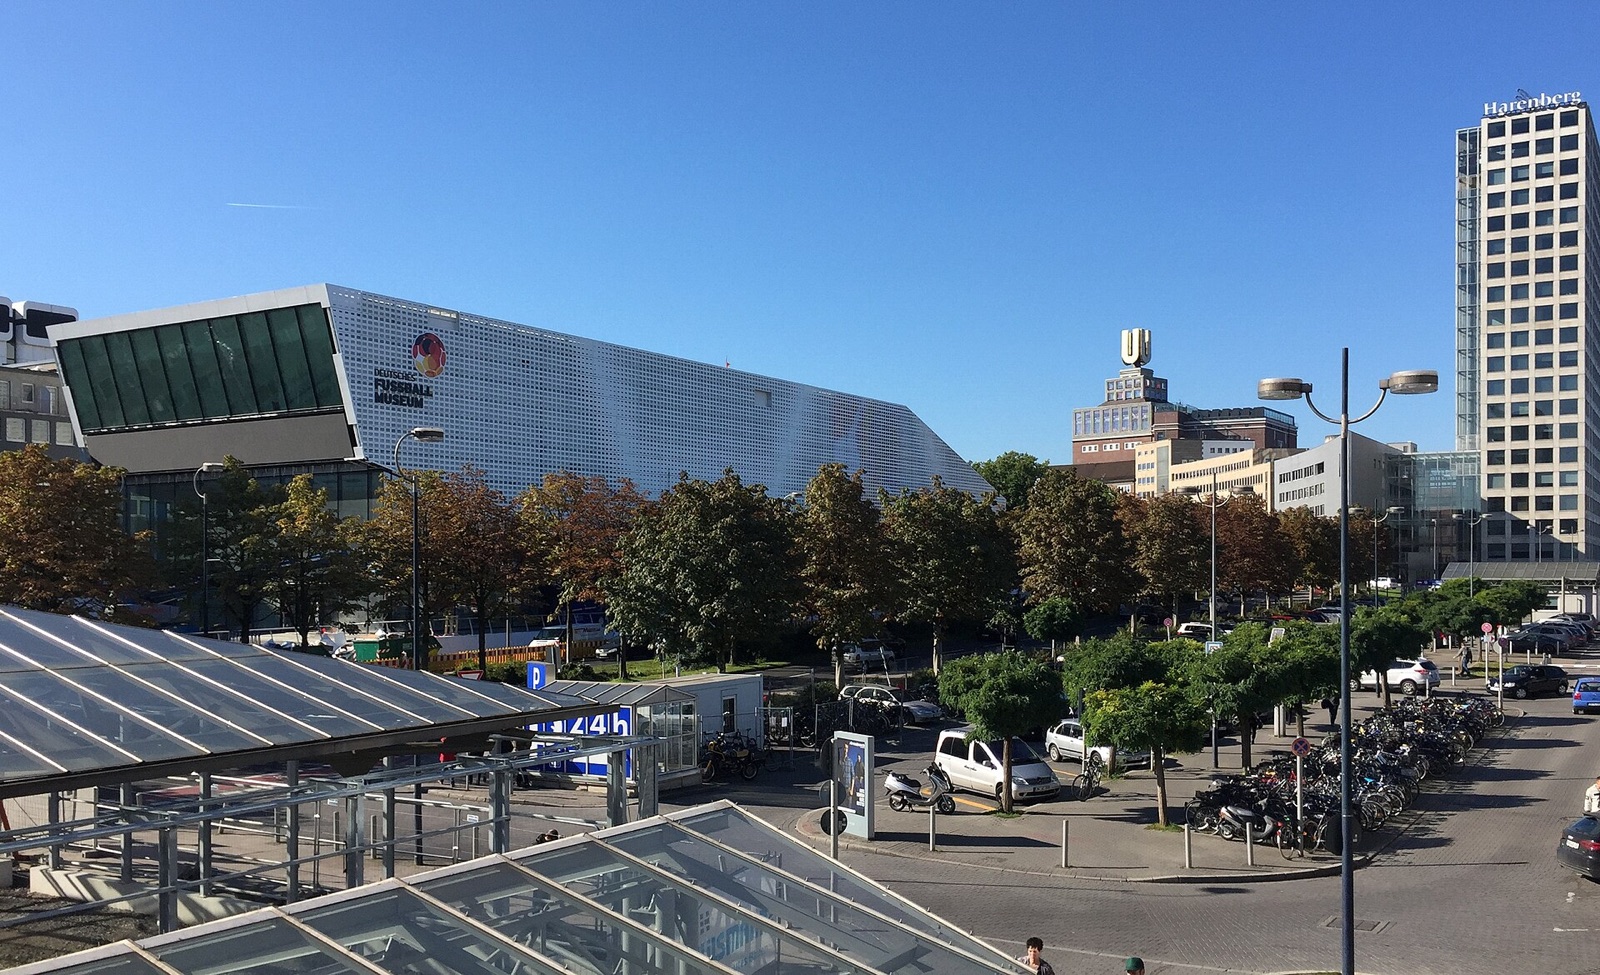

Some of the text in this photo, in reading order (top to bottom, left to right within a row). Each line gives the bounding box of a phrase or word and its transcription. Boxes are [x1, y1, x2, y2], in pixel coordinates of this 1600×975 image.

[1484, 91, 1581, 116] Harenberg
[374, 368, 416, 381] DEUTSCHES
[374, 378, 433, 397] FUSSBALL
[374, 392, 424, 409] MUSEUM
[532, 667, 540, 689] P
